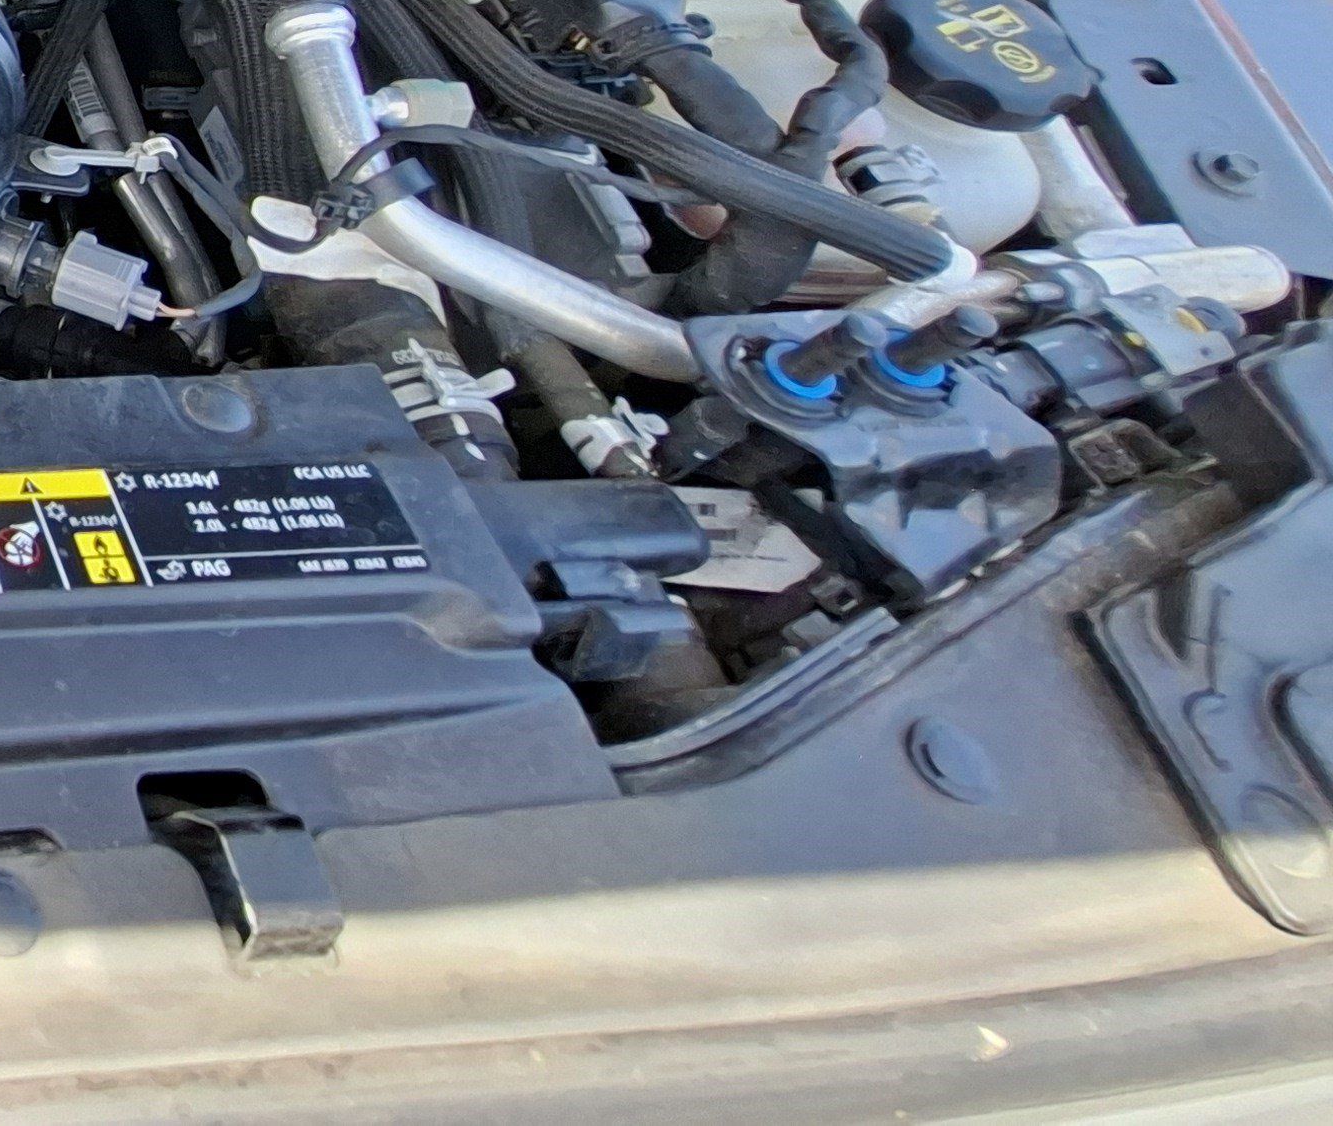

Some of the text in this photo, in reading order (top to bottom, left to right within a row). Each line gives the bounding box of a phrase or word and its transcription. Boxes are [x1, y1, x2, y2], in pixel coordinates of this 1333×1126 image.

[142, 470, 220, 490] R-1234yf
[293, 464, 373, 480] FCA US LLC
[191, 559, 232, 577] PAG
